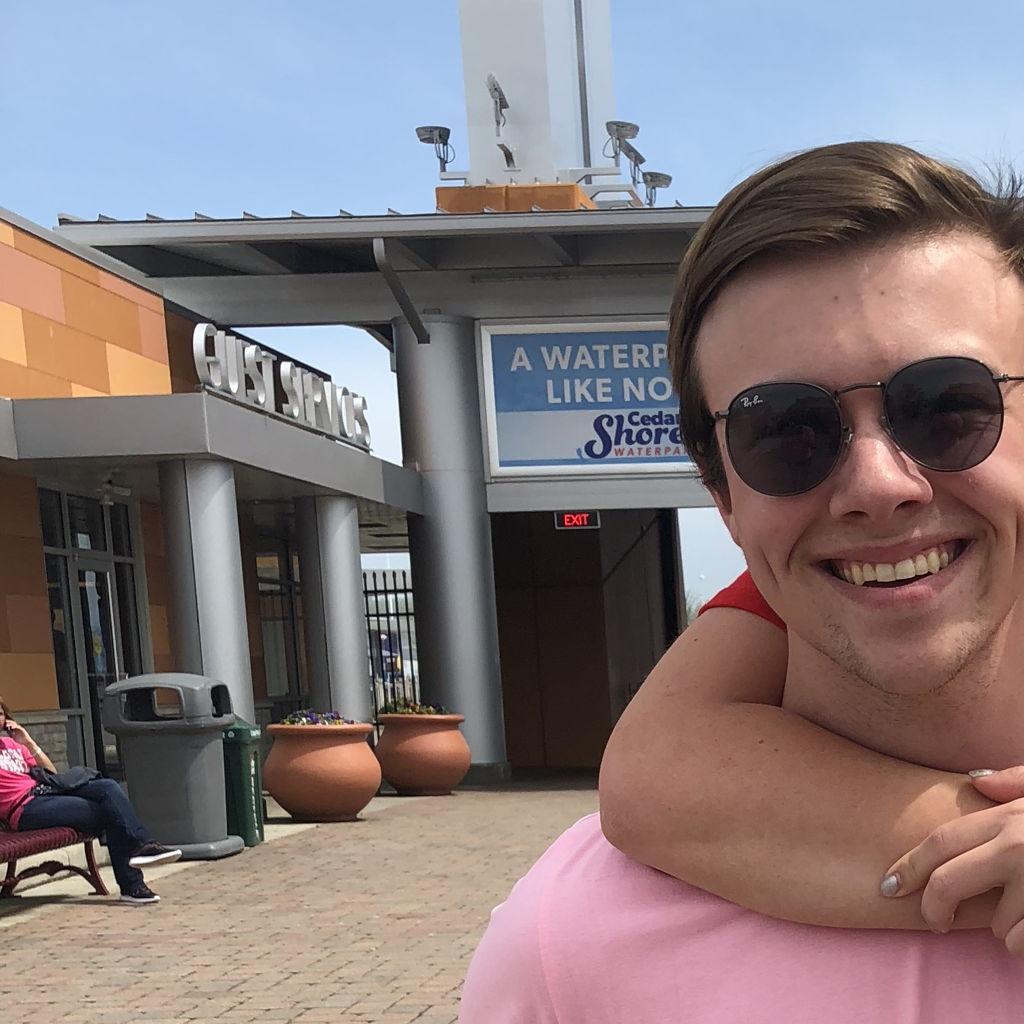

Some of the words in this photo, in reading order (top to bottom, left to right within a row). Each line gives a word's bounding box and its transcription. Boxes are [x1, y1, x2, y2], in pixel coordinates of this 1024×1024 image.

[510, 346, 533, 372] A
[546, 378, 613, 404] LIKE
[622, 376, 673, 403] NO
[564, 513, 589, 526] EXIT
